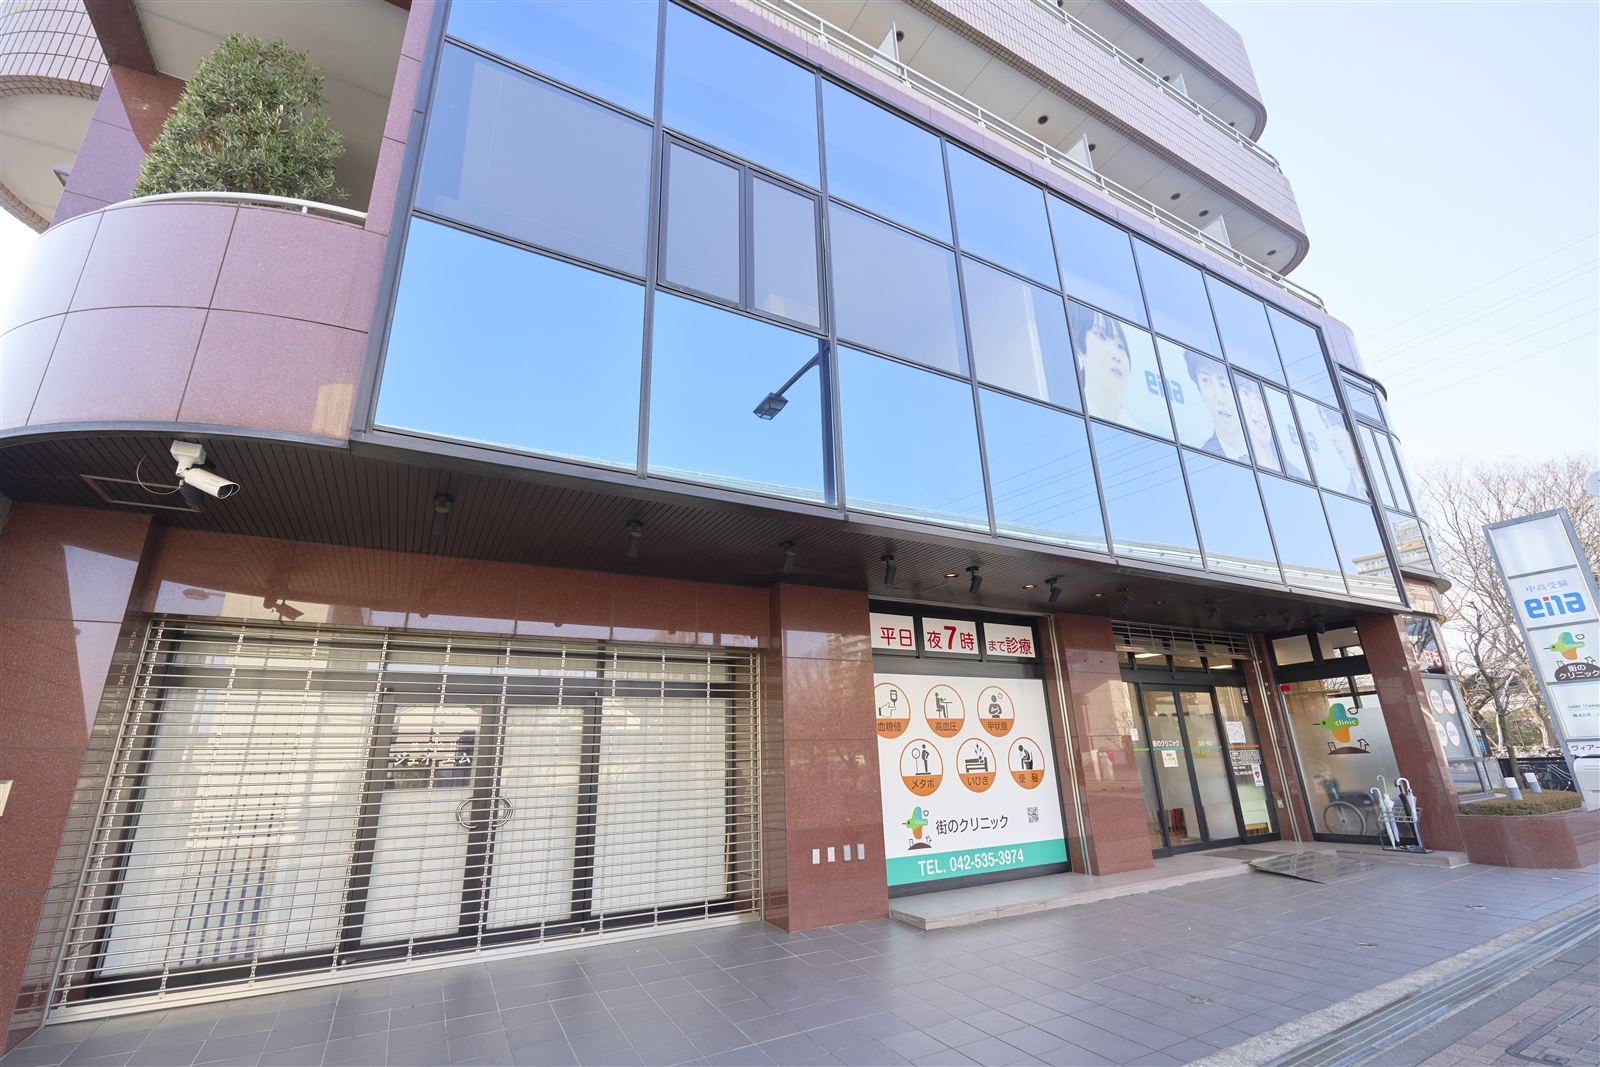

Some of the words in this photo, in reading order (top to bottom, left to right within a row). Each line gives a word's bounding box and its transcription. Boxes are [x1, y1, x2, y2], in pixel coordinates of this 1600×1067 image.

[880, 627, 913, 647] 平日
[927, 625, 975, 652] 夜7時
[988, 636, 1033, 655] まで診療
[1559, 670, 1600, 680] クリニック
[934, 721, 958, 732] 高血圧
[911, 777, 935, 789] メタボ
[967, 774, 989, 786] いびき
[935, 815, 1009, 836] 街のクリニック
[917, 857, 947, 877] TEL.
[950, 848, 1025, 872] 042-535-3974
